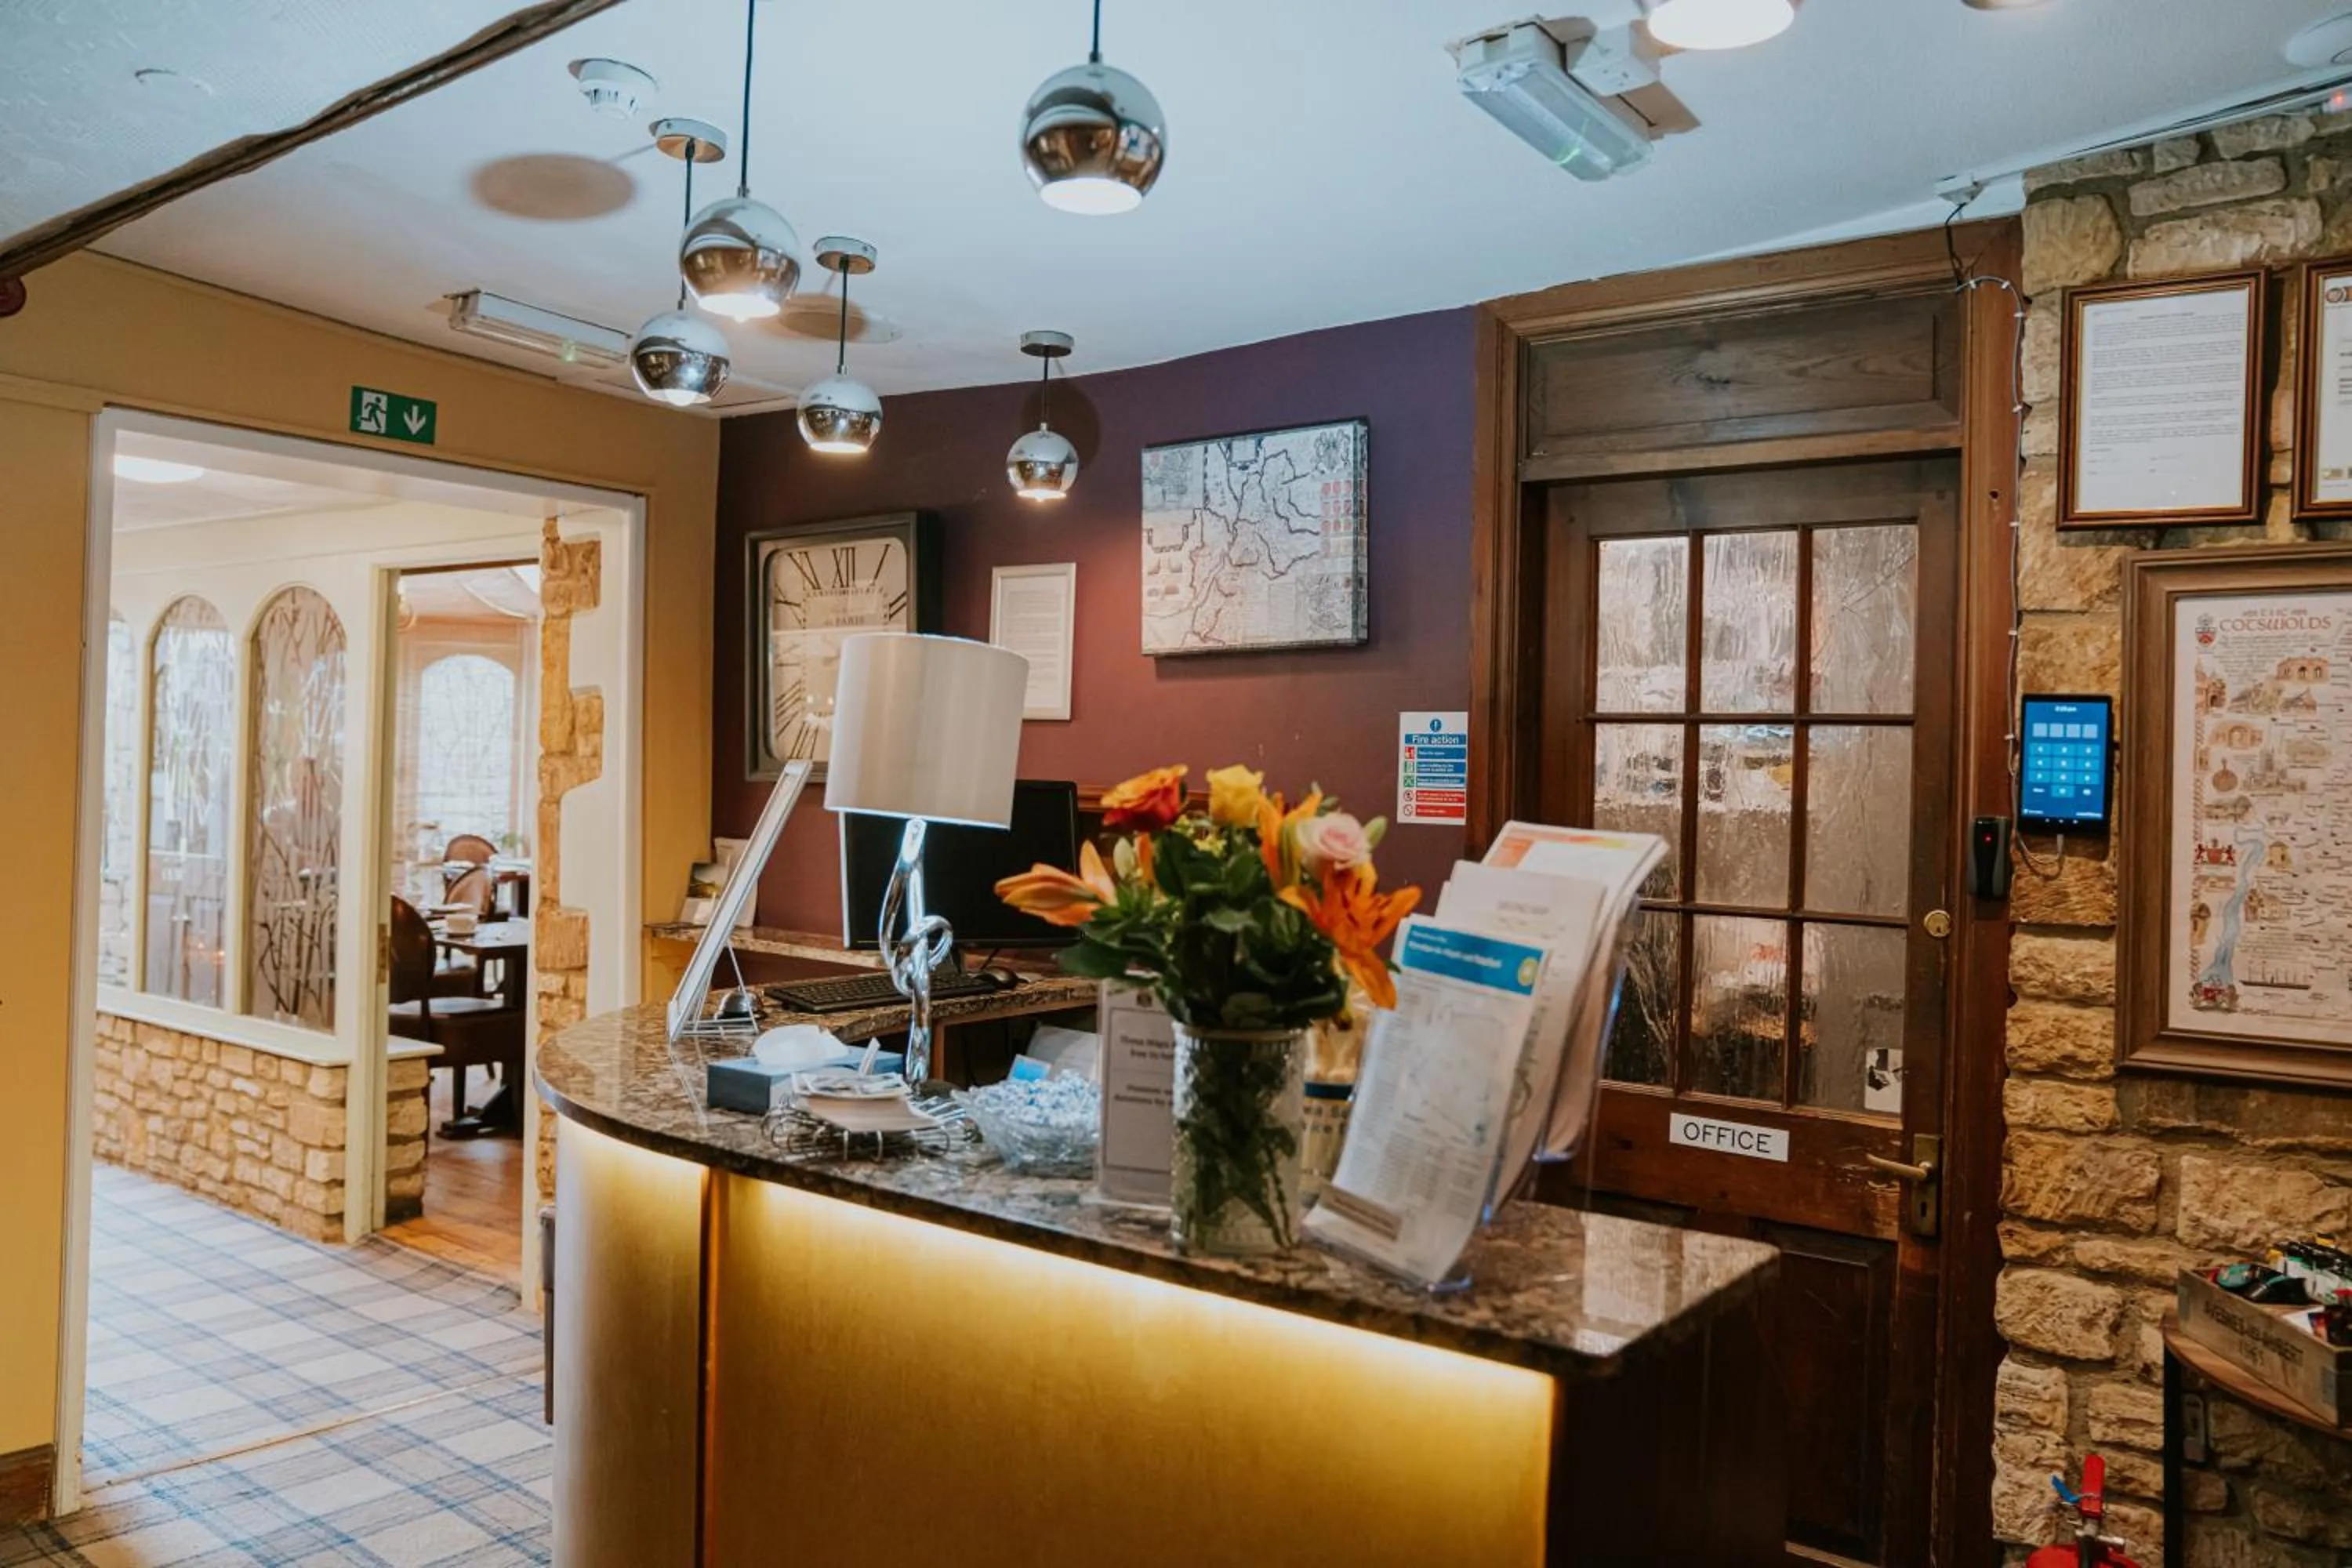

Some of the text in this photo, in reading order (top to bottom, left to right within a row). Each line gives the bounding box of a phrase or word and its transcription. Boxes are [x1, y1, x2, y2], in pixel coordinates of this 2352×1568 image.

[831, 546, 855, 588] XII
[2219, 615, 2332, 633] COTSWOLDS
[1412, 735, 1459, 745] Fire action
[1683, 1122, 1772, 1153] OFFICE
